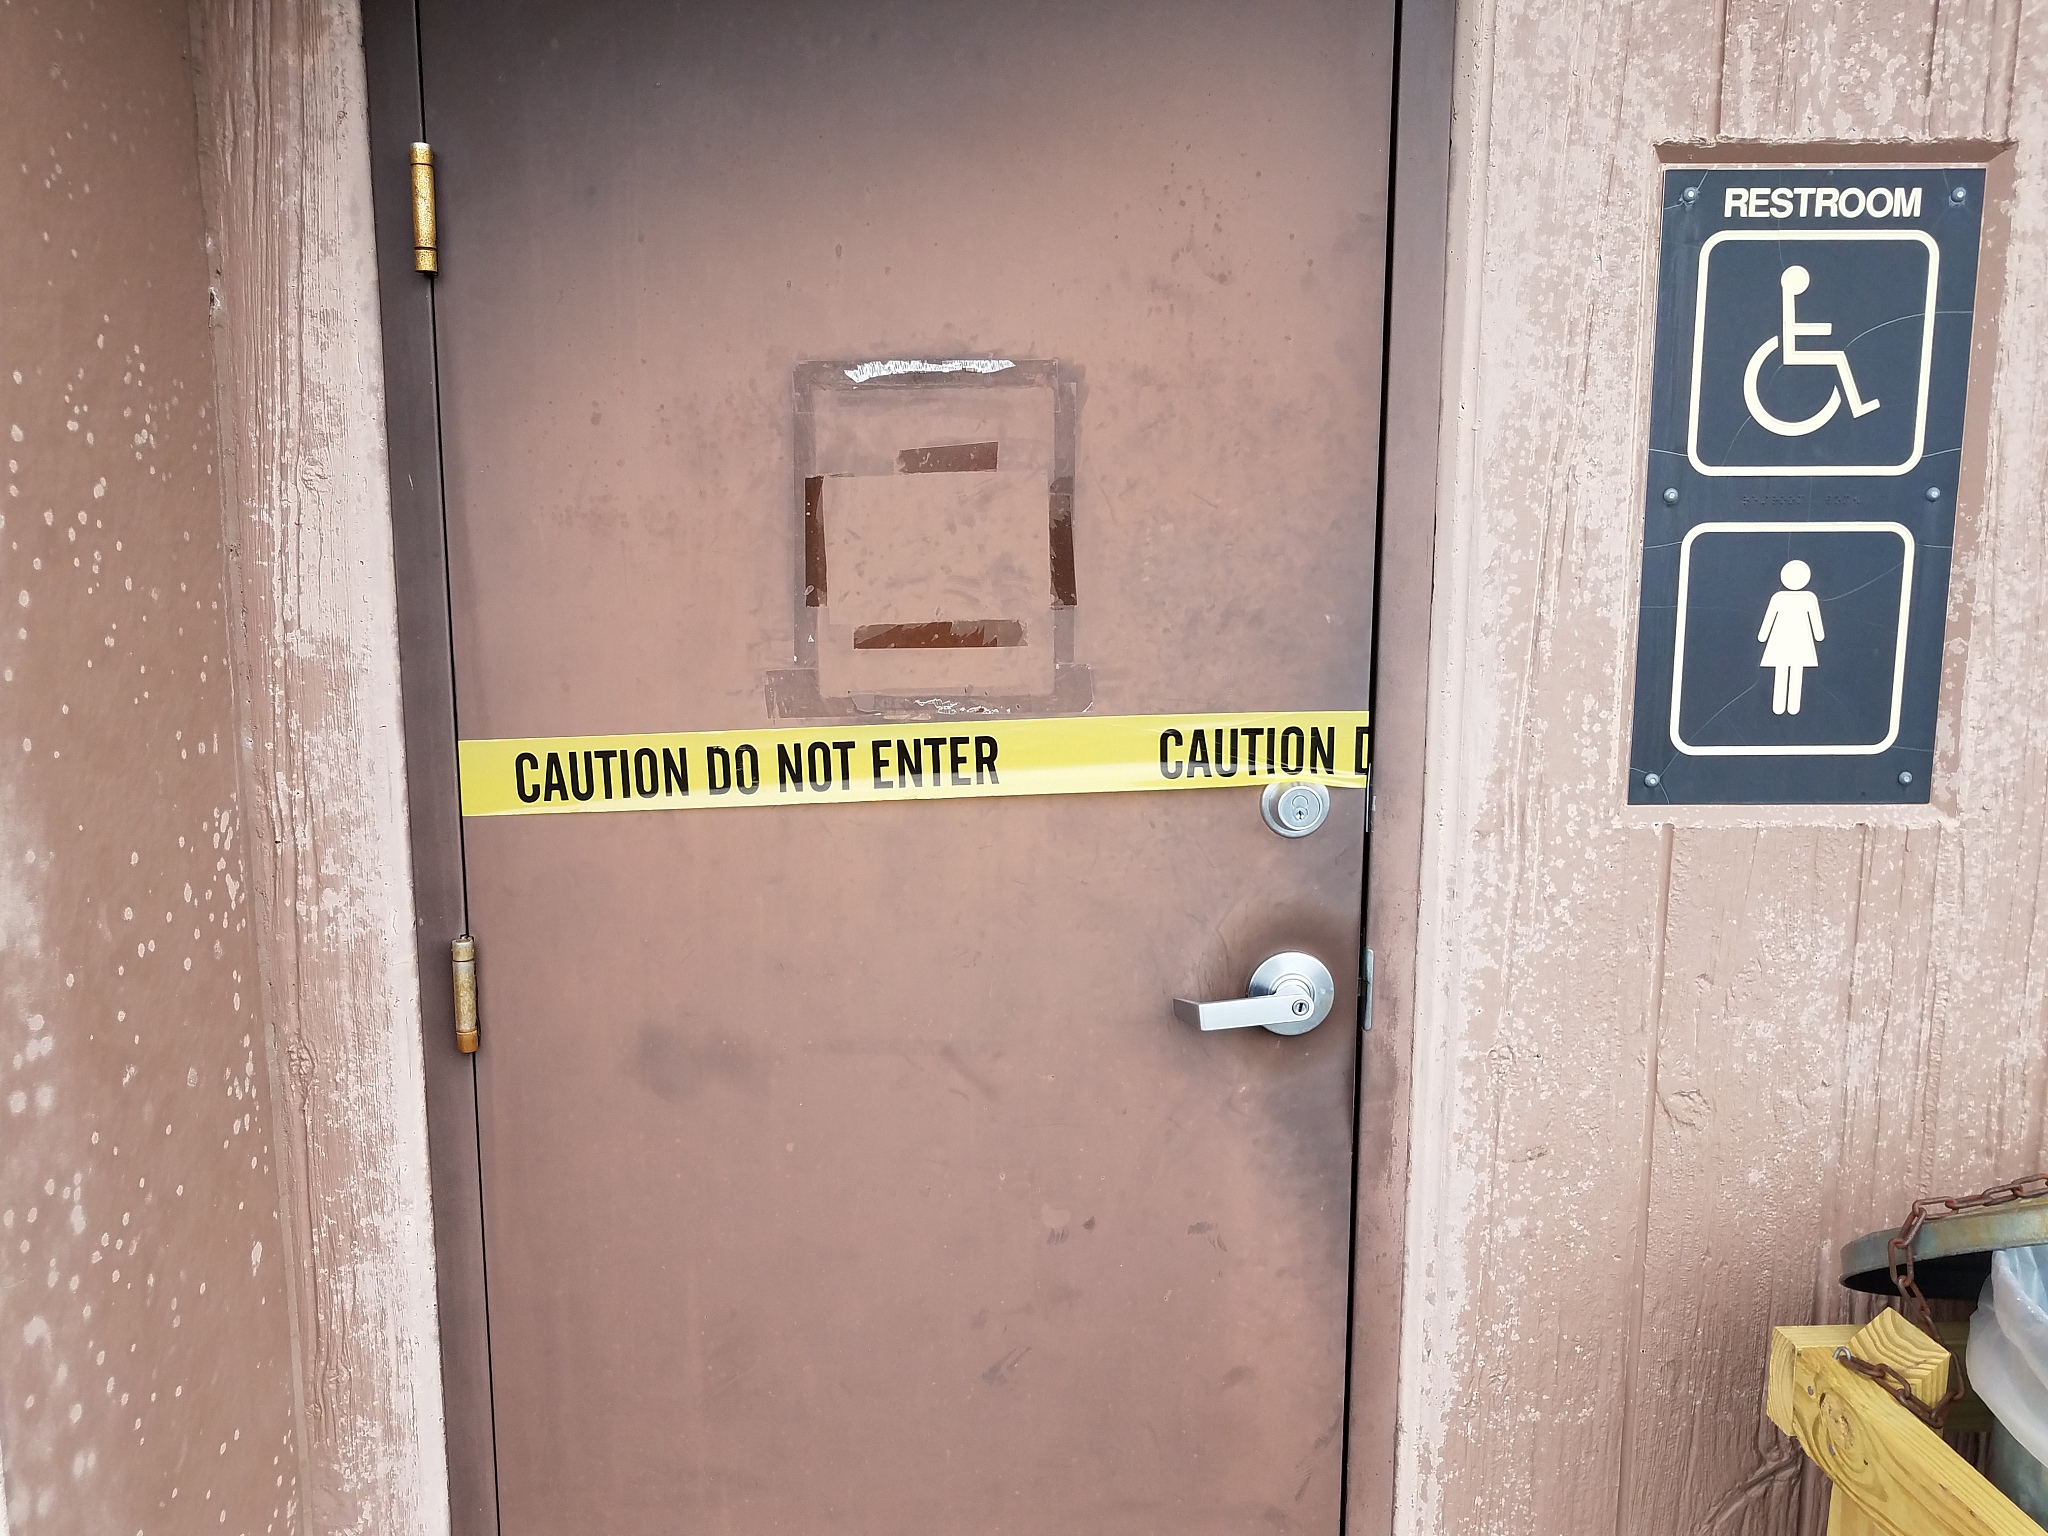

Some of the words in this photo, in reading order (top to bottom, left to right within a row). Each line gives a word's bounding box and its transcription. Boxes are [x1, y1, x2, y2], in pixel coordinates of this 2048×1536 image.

[1723, 187, 1922, 218] RESTROOM
[514, 747, 689, 803] CAUTION
[706, 744, 759, 796] DO
[777, 740, 856, 793] NOT
[871, 736, 999, 790] ENTER
[1158, 726, 1335, 779] CAUTION
